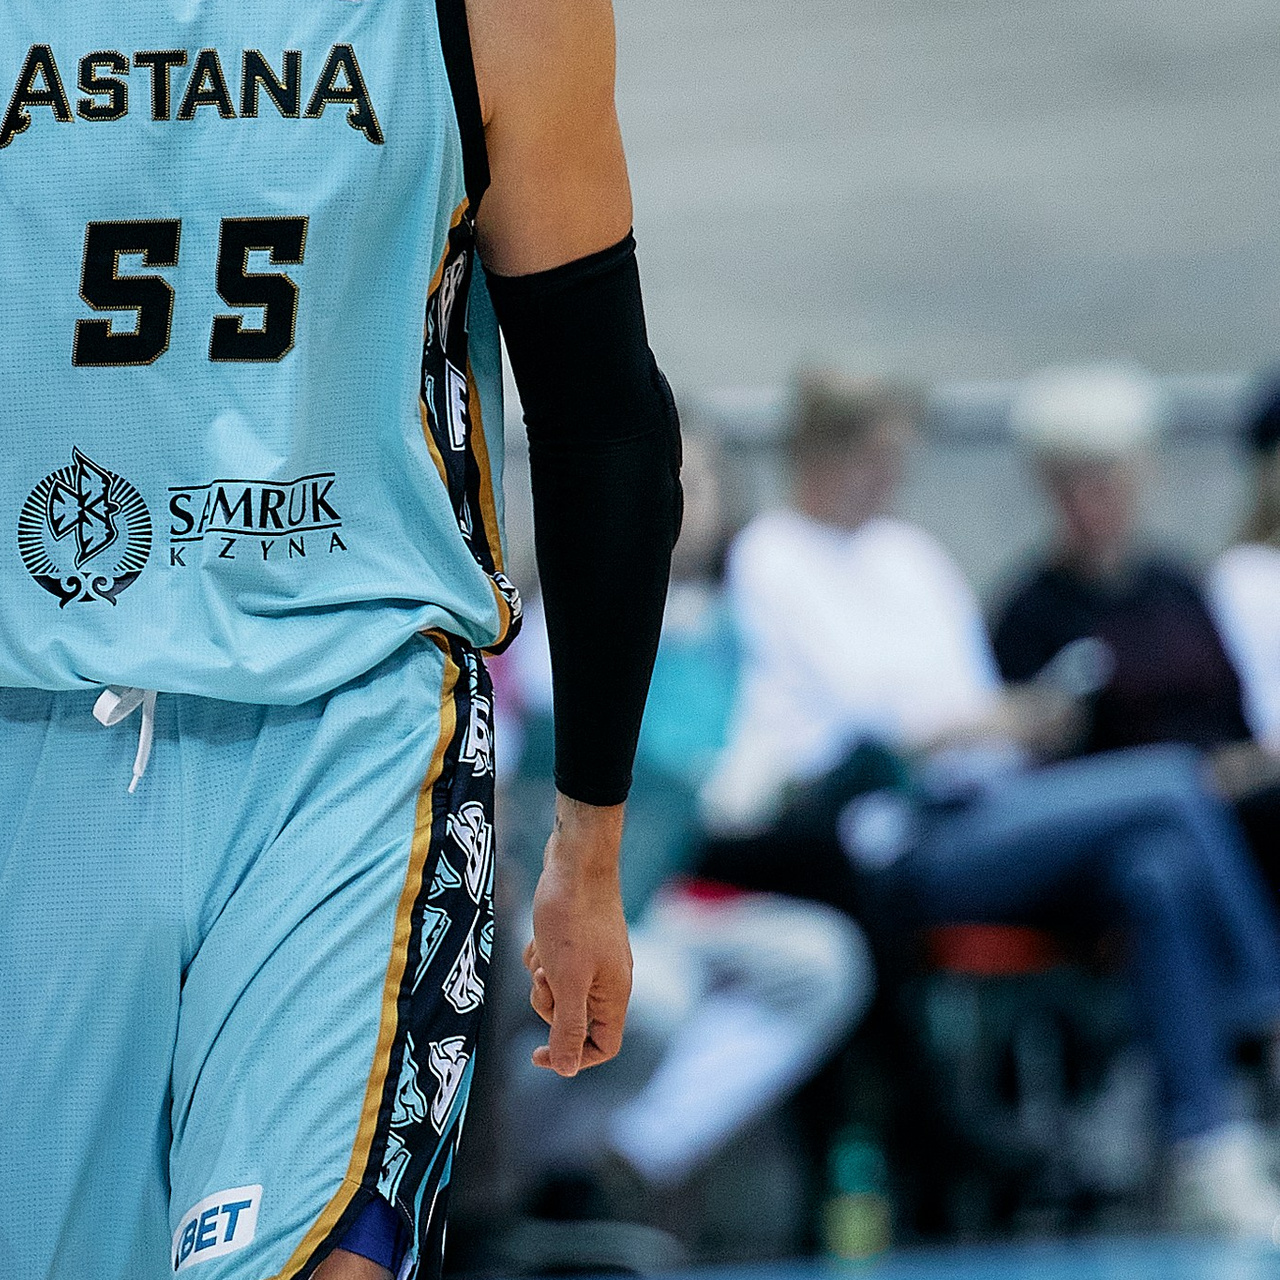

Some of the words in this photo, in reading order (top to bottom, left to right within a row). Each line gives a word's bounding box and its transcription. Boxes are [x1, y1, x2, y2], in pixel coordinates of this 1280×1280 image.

[72, 214, 310, 368] 55
[170, 531, 348, 567] KZYNA
[174, 1199, 253, 1272] BET
